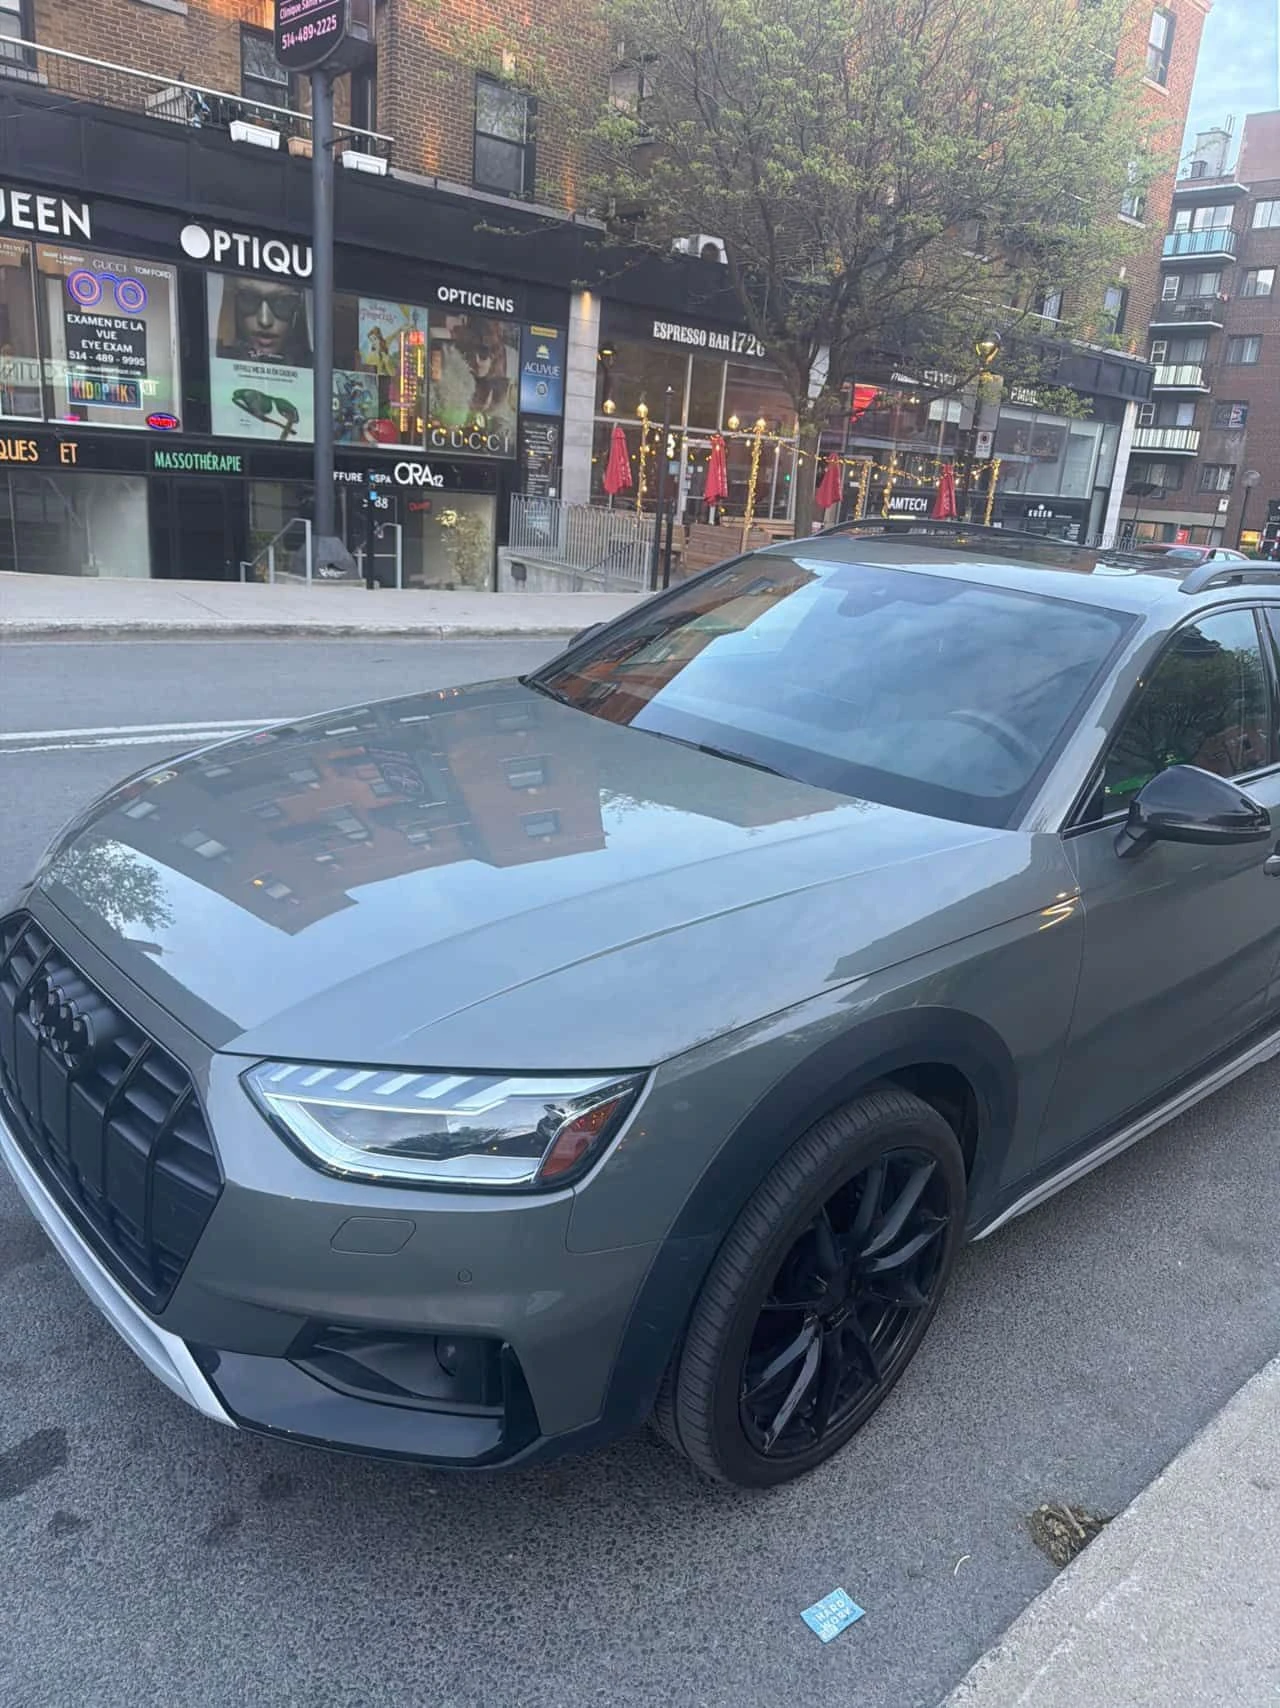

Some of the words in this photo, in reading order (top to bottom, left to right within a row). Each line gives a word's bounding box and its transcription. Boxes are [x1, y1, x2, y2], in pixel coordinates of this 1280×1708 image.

[93, 258, 126, 273] GUCCI
[134, 266, 153, 277] TOM
[437, 286, 514, 313] OPTICIENS
[67, 313, 112, 328] EXAMEN
[114, 319, 129, 330] DE
[130, 321, 145, 332] LA
[96, 328, 118, 340] VUE
[653, 320, 706, 347] ESPRESSO
[708, 331, 730, 351] BAR
[81, 339, 101, 350] EYE
[103, 342, 133, 354] EXAM
[69, 350, 87, 361] 514
[95, 353, 115, 363] 489
[523, 361, 561, 378] ACUVUE
[431, 428, 511, 454] GUCCI
[60, 442, 79, 464] ET
[154, 450, 243, 472] MASSOTHÉRAPIE
[375, 473, 392, 484] SPA
